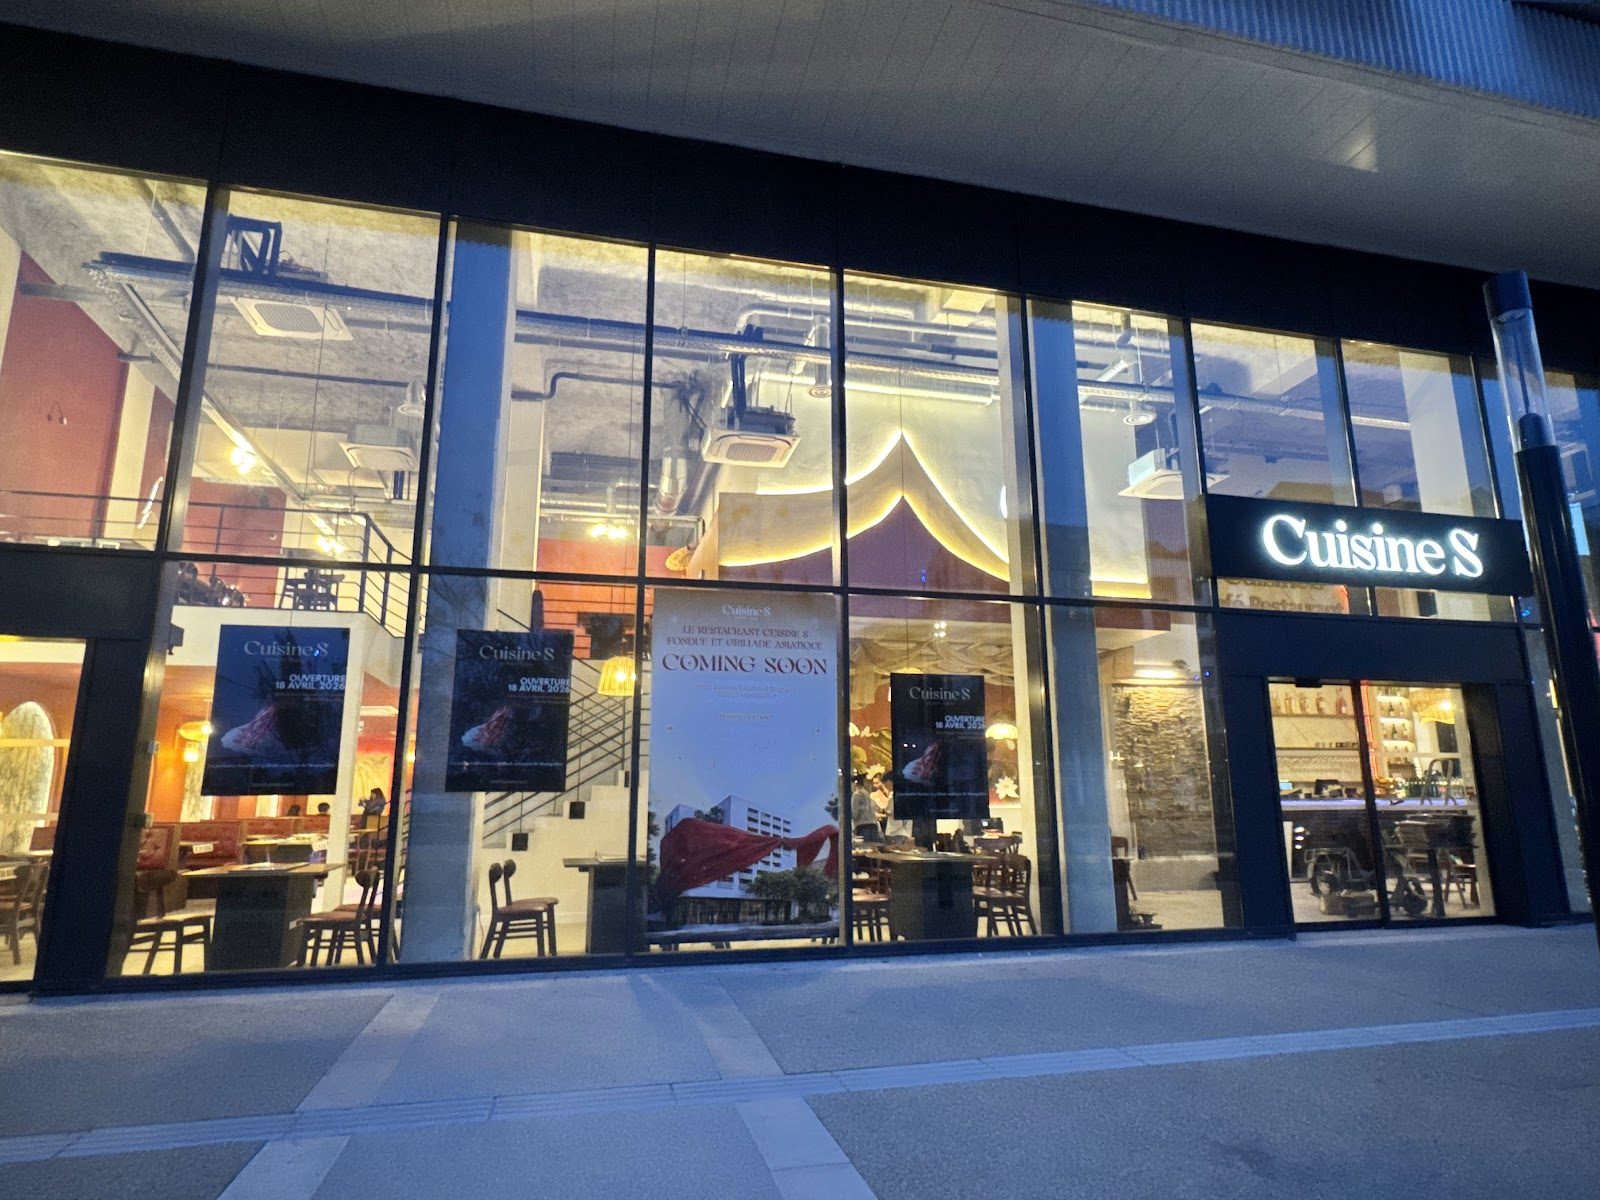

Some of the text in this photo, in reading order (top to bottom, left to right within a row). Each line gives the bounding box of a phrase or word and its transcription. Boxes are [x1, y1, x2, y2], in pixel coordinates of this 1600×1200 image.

[1262, 514, 1484, 578] Cuisine S
[722, 605, 763, 616] Cuisine
[683, 625, 809, 639] LE RESTAURANT CUISINE S
[243, 640, 329, 657] Cuisine S
[667, 636, 823, 650] FONDUE ET GRILLADE ASIATIQUE
[479, 645, 554, 660] Cuisine S
[662, 653, 827, 674] COMING SOON
[289, 673, 345, 682] OUVERTURE
[520, 677, 571, 686] OUVERTURE
[275, 681, 345, 690] 18 AVRIL 2026
[519, 684, 545, 692] AVRIL
[547, 685, 570, 693] 2026
[909, 686, 971, 700] Cuisine S
[944, 715, 985, 723] OUVERTURE
[944, 721, 965, 729] AVRIL
